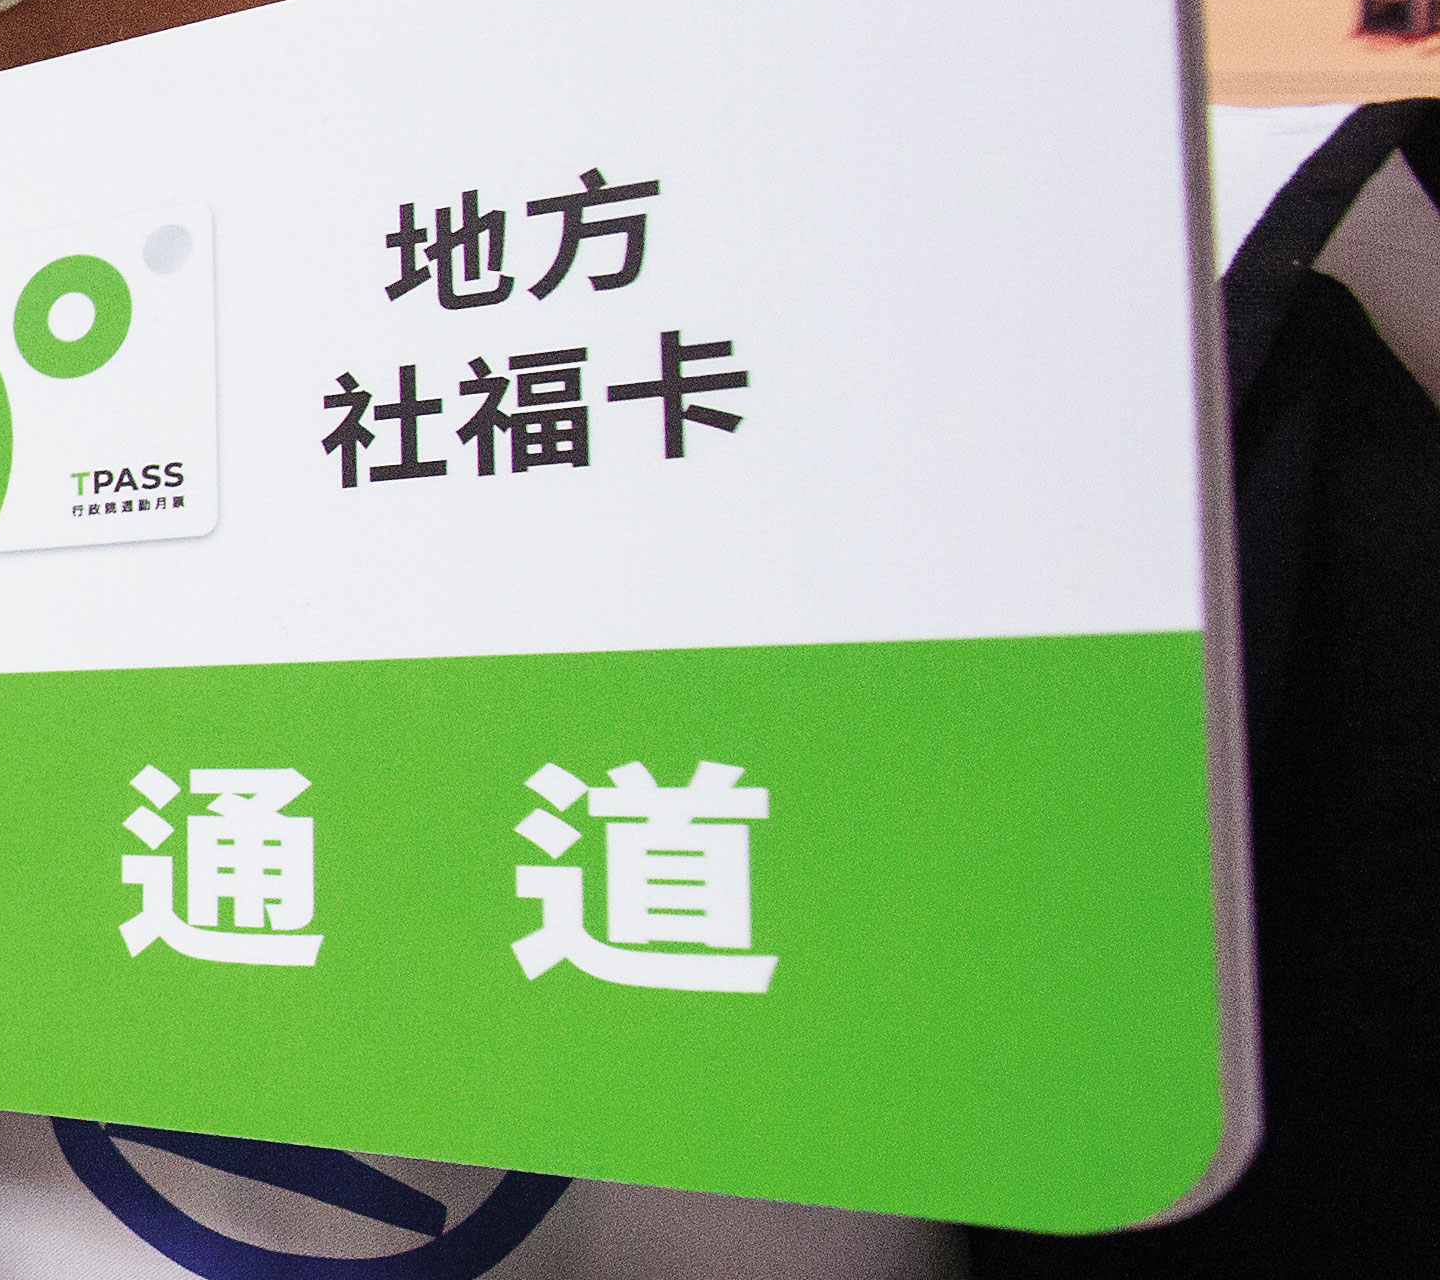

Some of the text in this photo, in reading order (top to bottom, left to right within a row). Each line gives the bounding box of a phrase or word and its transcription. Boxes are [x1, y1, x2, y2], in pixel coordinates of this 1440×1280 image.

[384, 167, 660, 311] 地方
[70, 461, 184, 496] TPASS
[321, 330, 749, 489] 社福卡
